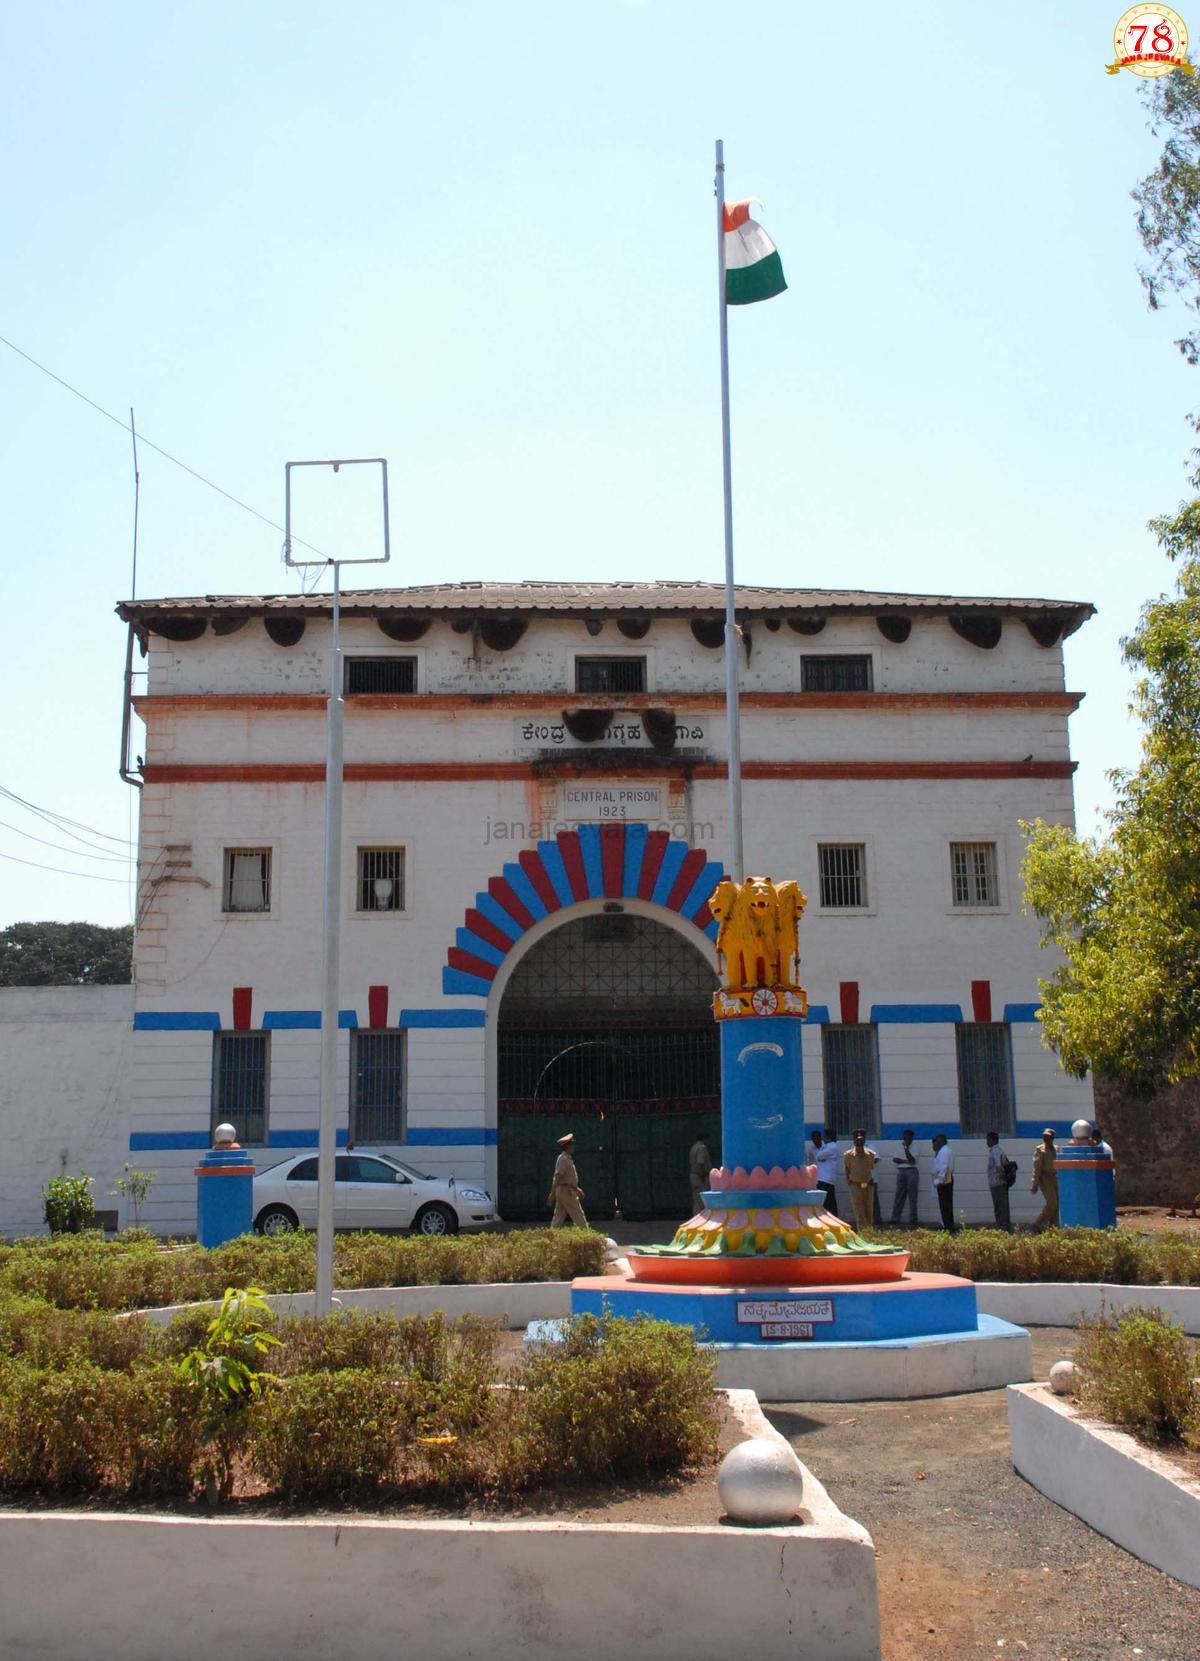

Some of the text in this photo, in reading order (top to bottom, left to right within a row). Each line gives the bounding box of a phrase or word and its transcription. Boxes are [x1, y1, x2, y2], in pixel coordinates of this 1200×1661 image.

[522, 723, 566, 744] ಕೇಂದ್ರ
[567, 791, 659, 803] CENTRAL PRISON
[598, 806, 626, 817] 1923
